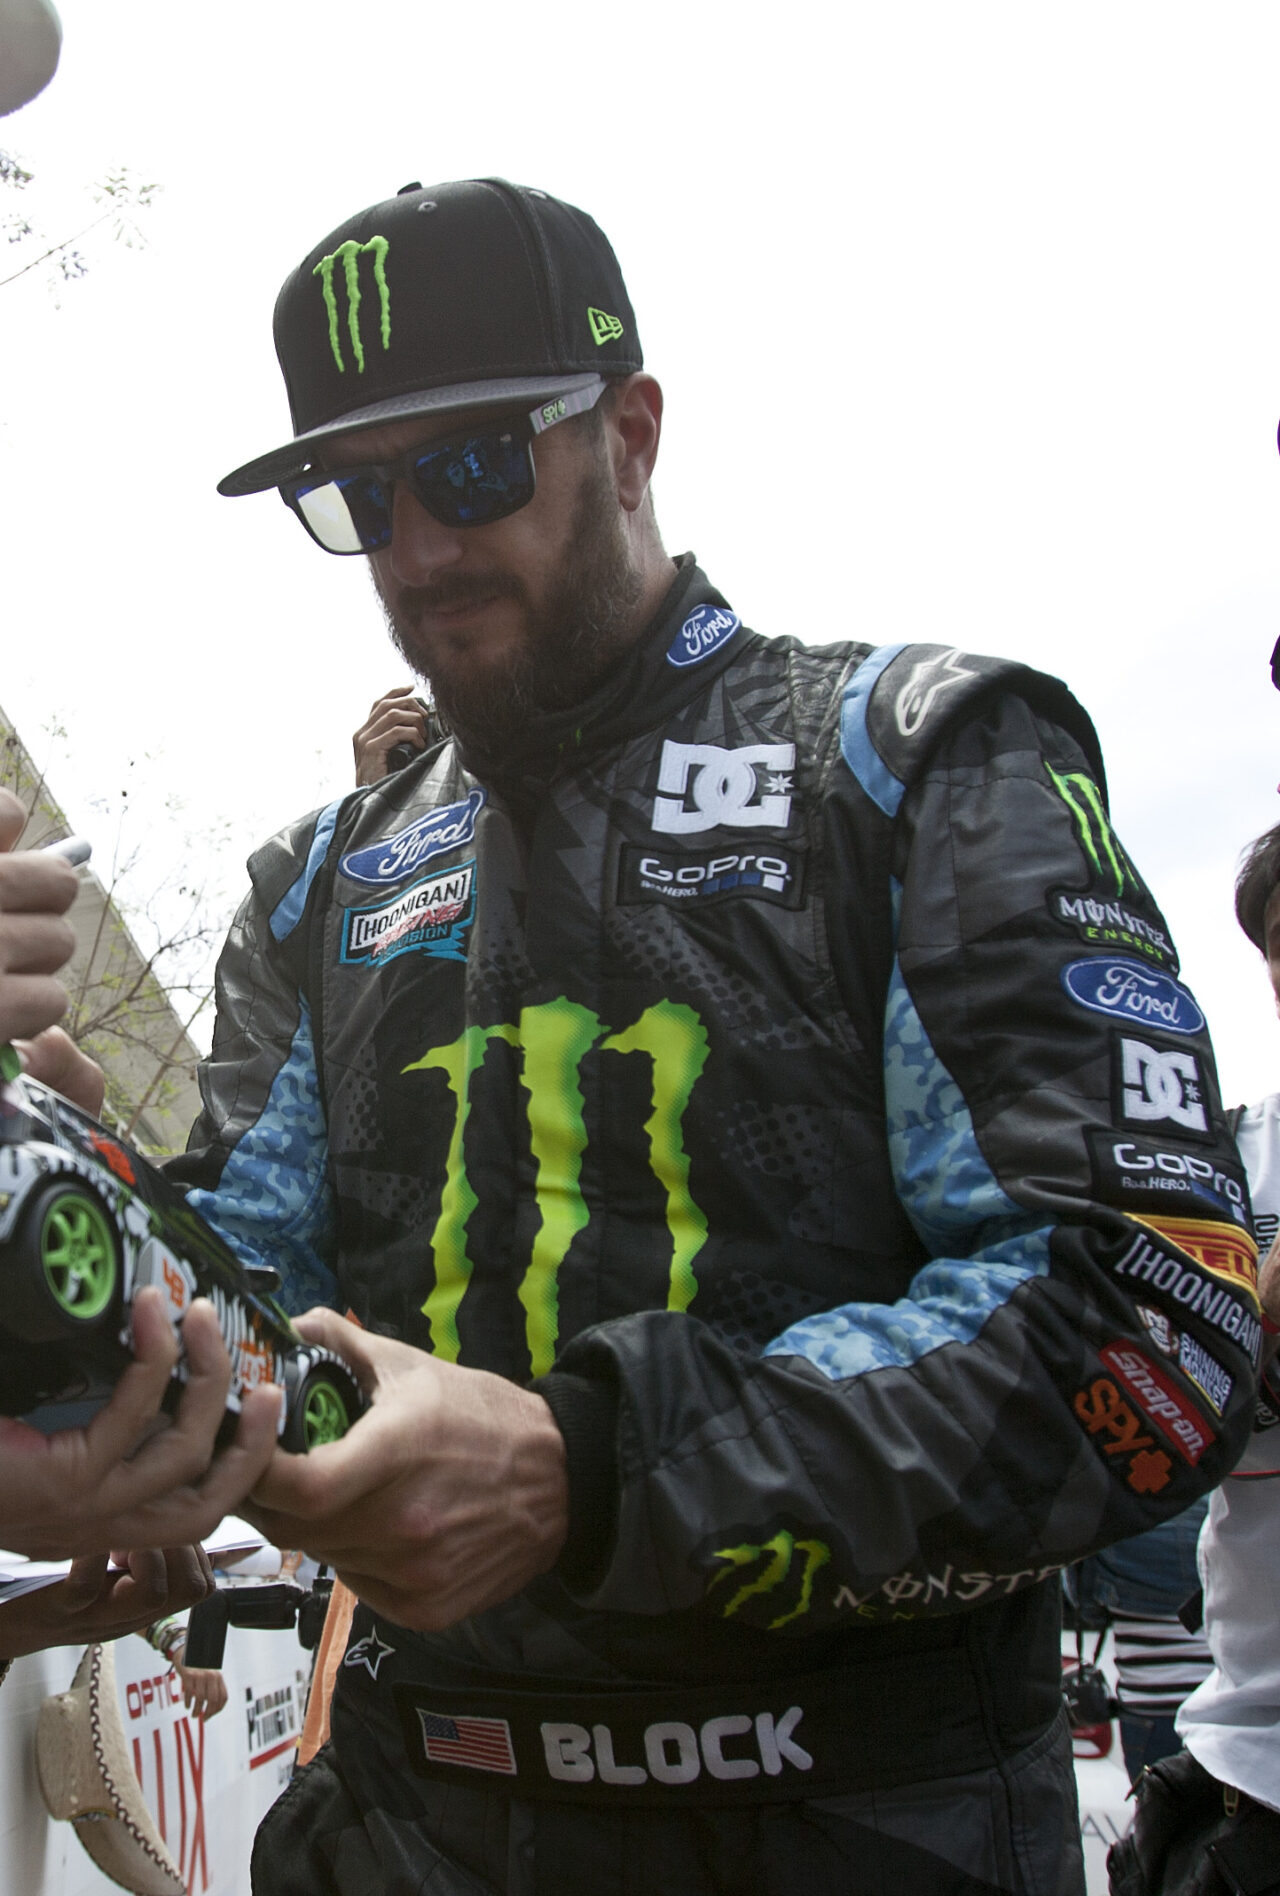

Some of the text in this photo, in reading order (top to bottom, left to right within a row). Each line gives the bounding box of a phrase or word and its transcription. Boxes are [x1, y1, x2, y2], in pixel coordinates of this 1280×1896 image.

[682, 609, 733, 655] Ford
[652, 739, 795, 834] DC
[378, 809, 470, 875] Ford
[640, 855, 788, 883] GoPro
[1086, 927, 1163, 961] ENERGY
[1097, 965, 1181, 1025] Ford
[1122, 1038, 1209, 1132] DC
[1113, 1143, 1242, 1203] GoPro
[126, 1672, 185, 1720] OPTIC
[540, 1706, 814, 1786] BLOCK
